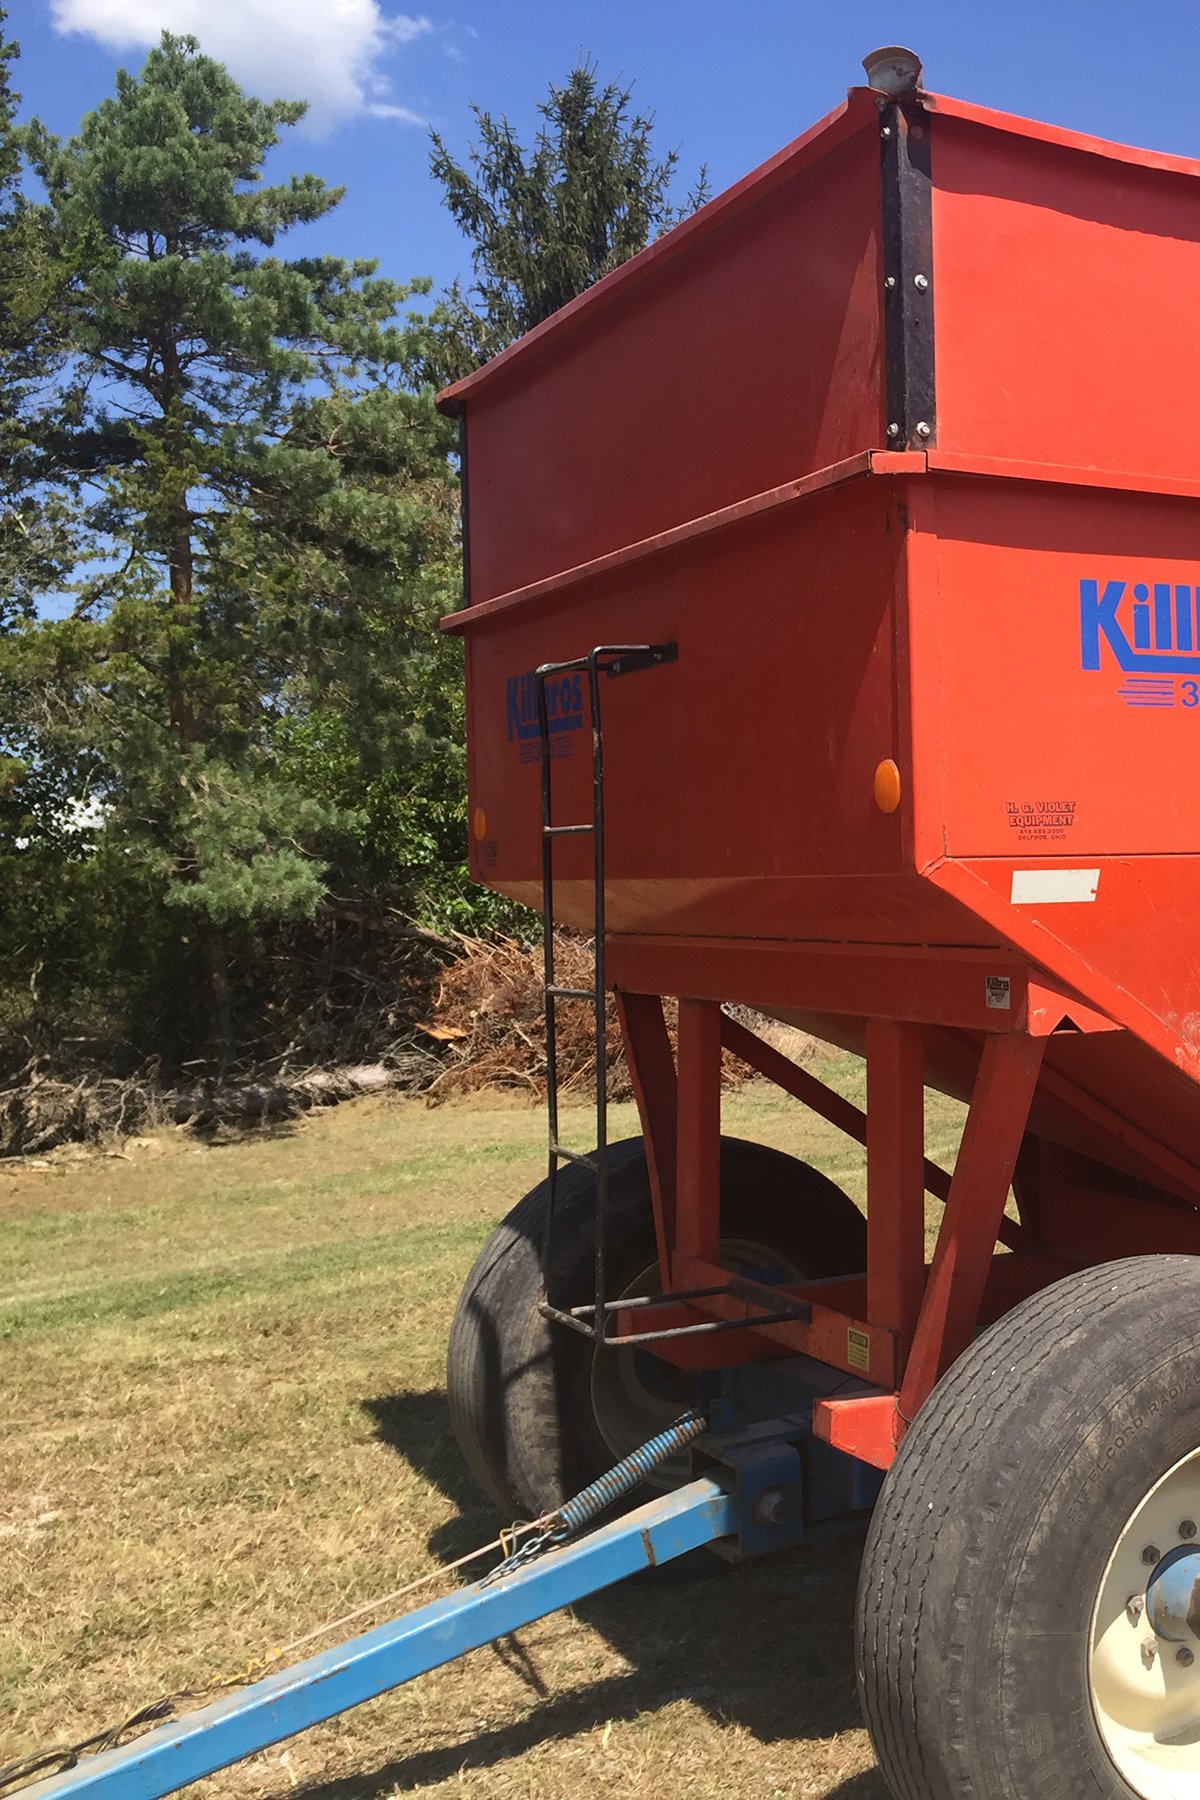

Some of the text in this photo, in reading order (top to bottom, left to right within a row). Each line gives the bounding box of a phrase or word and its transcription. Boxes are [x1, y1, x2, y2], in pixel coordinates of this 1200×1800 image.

[1006, 801, 1019, 814] H.
[1035, 801, 1076, 814] VIOLET
[1009, 814, 1075, 828] EQUIPMENT
